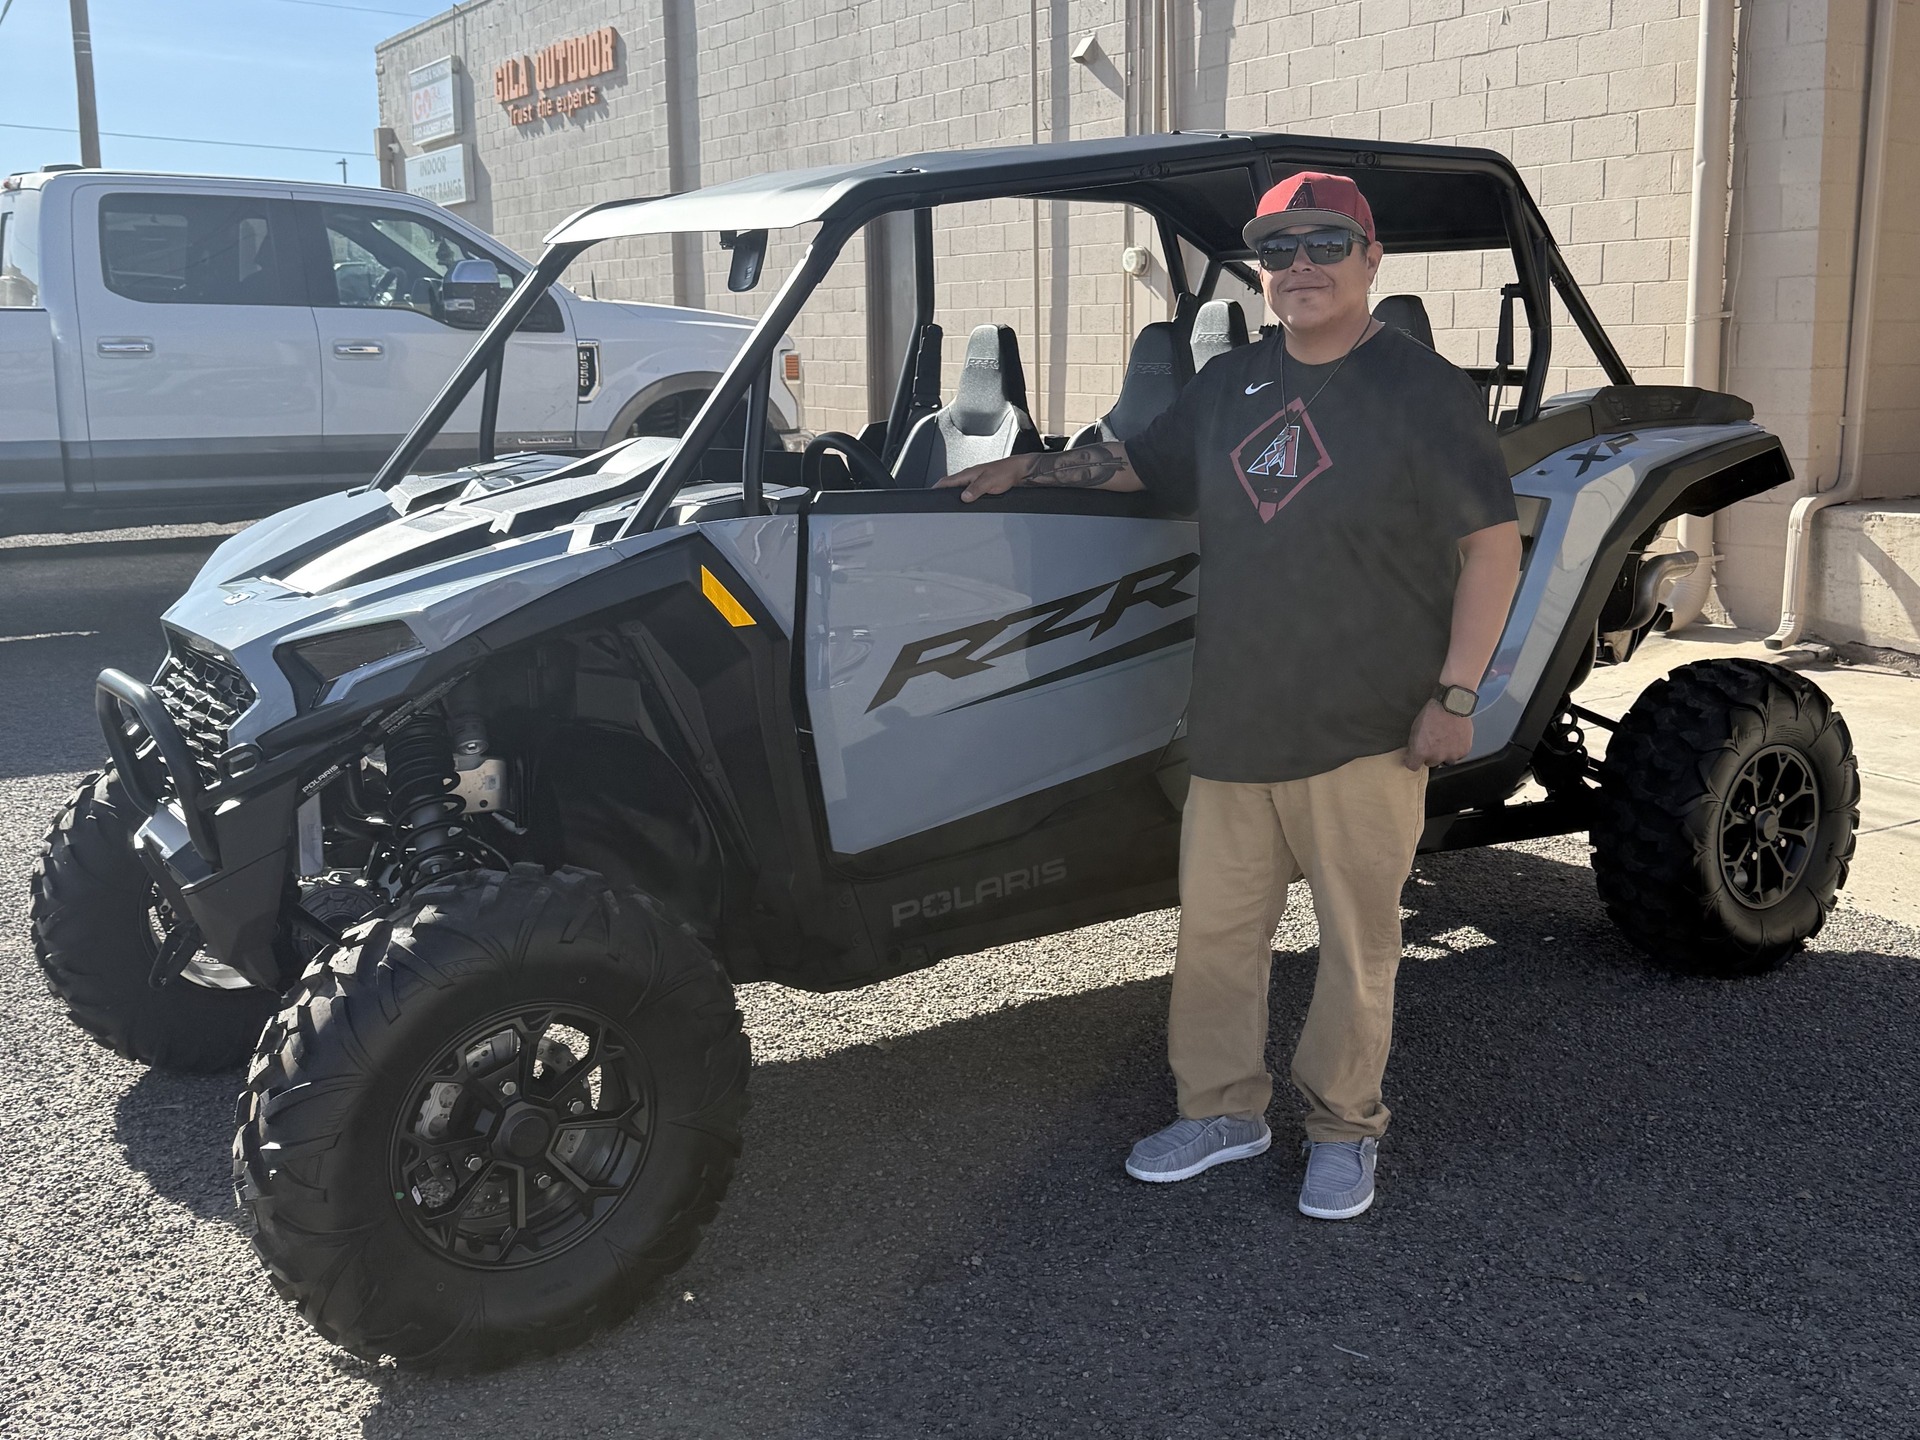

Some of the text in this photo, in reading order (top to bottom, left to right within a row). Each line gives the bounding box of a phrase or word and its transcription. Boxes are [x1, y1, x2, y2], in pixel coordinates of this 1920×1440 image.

[494, 55, 532, 104] GILA
[535, 26, 616, 92] OUTDOOR
[508, 86, 597, 126] Trust the experts
[420, 155, 447, 177] INDOOR
[438, 178, 463, 200] RANGE
[1566, 433, 1640, 478] XP
[864, 552, 1201, 716] RZR
[302, 764, 339, 793] POLARIS
[892, 858, 1068, 928] POLARIS
